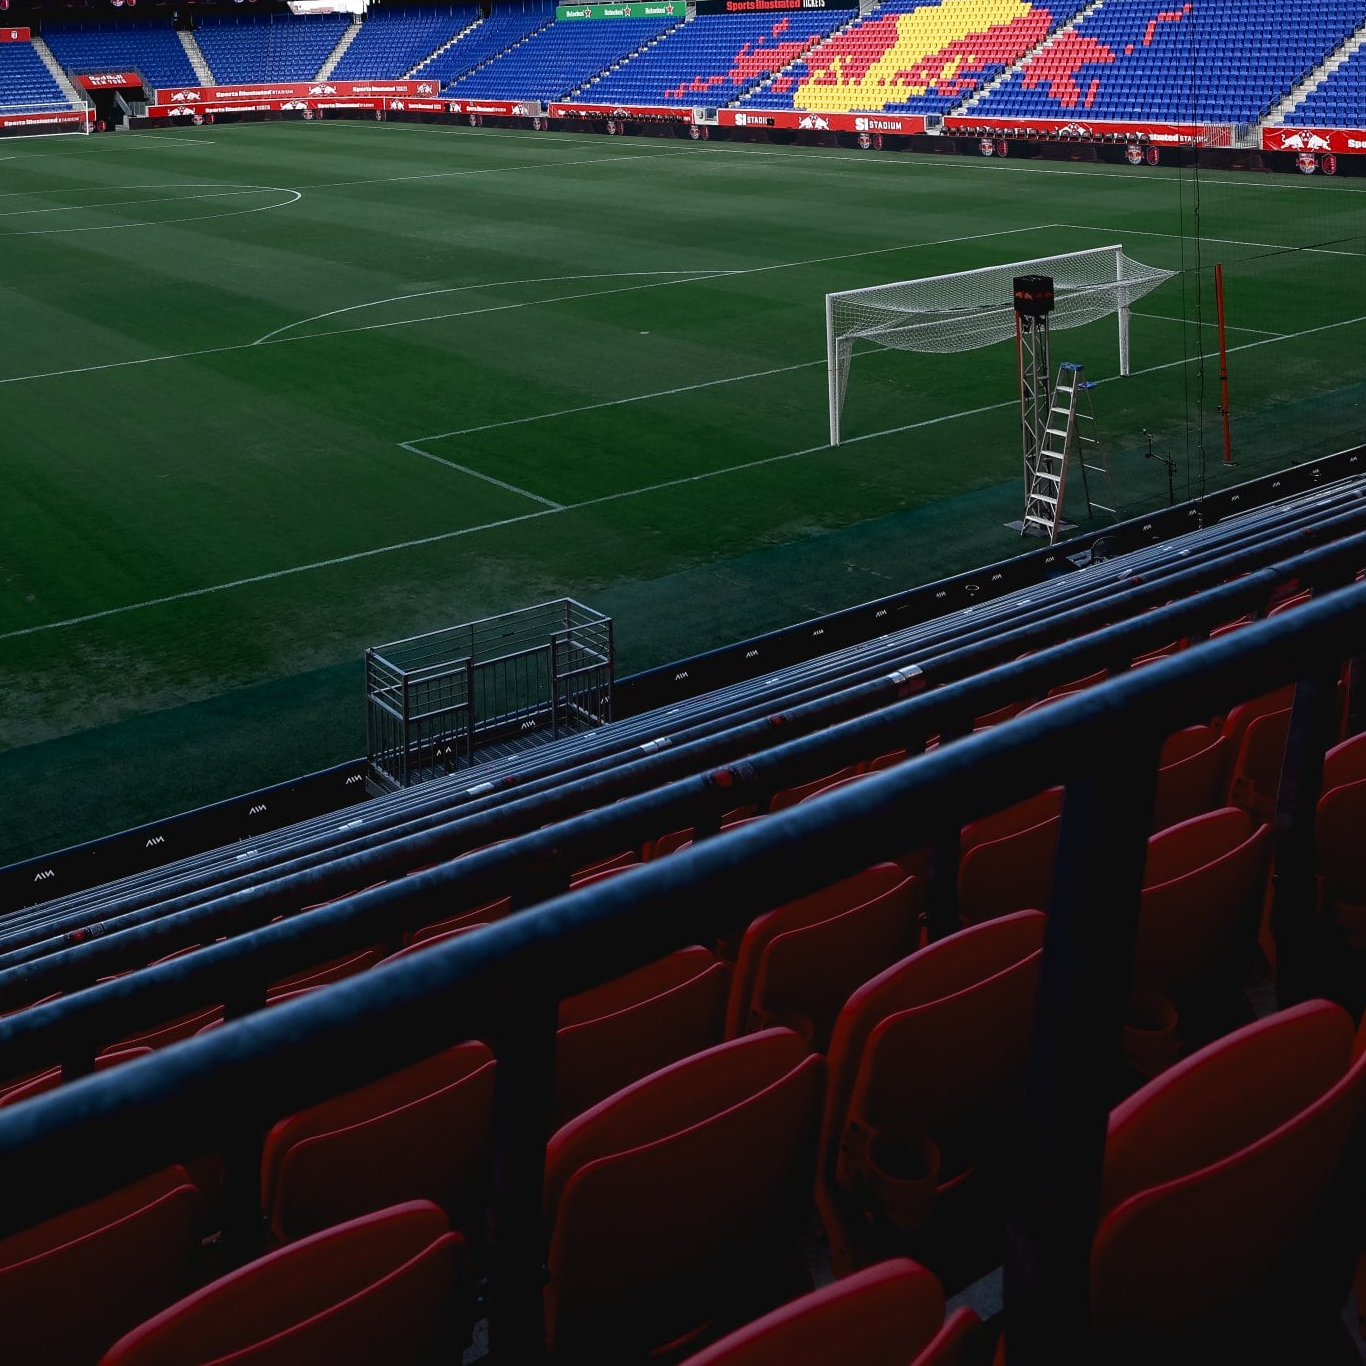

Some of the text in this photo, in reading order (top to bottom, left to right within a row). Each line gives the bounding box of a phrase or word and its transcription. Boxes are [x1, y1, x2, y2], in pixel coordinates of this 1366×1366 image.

[727, 0, 755, 12] Sports
[735, 113, 775, 126] SI STADI
[855, 118, 902, 131] SI STADIUM
